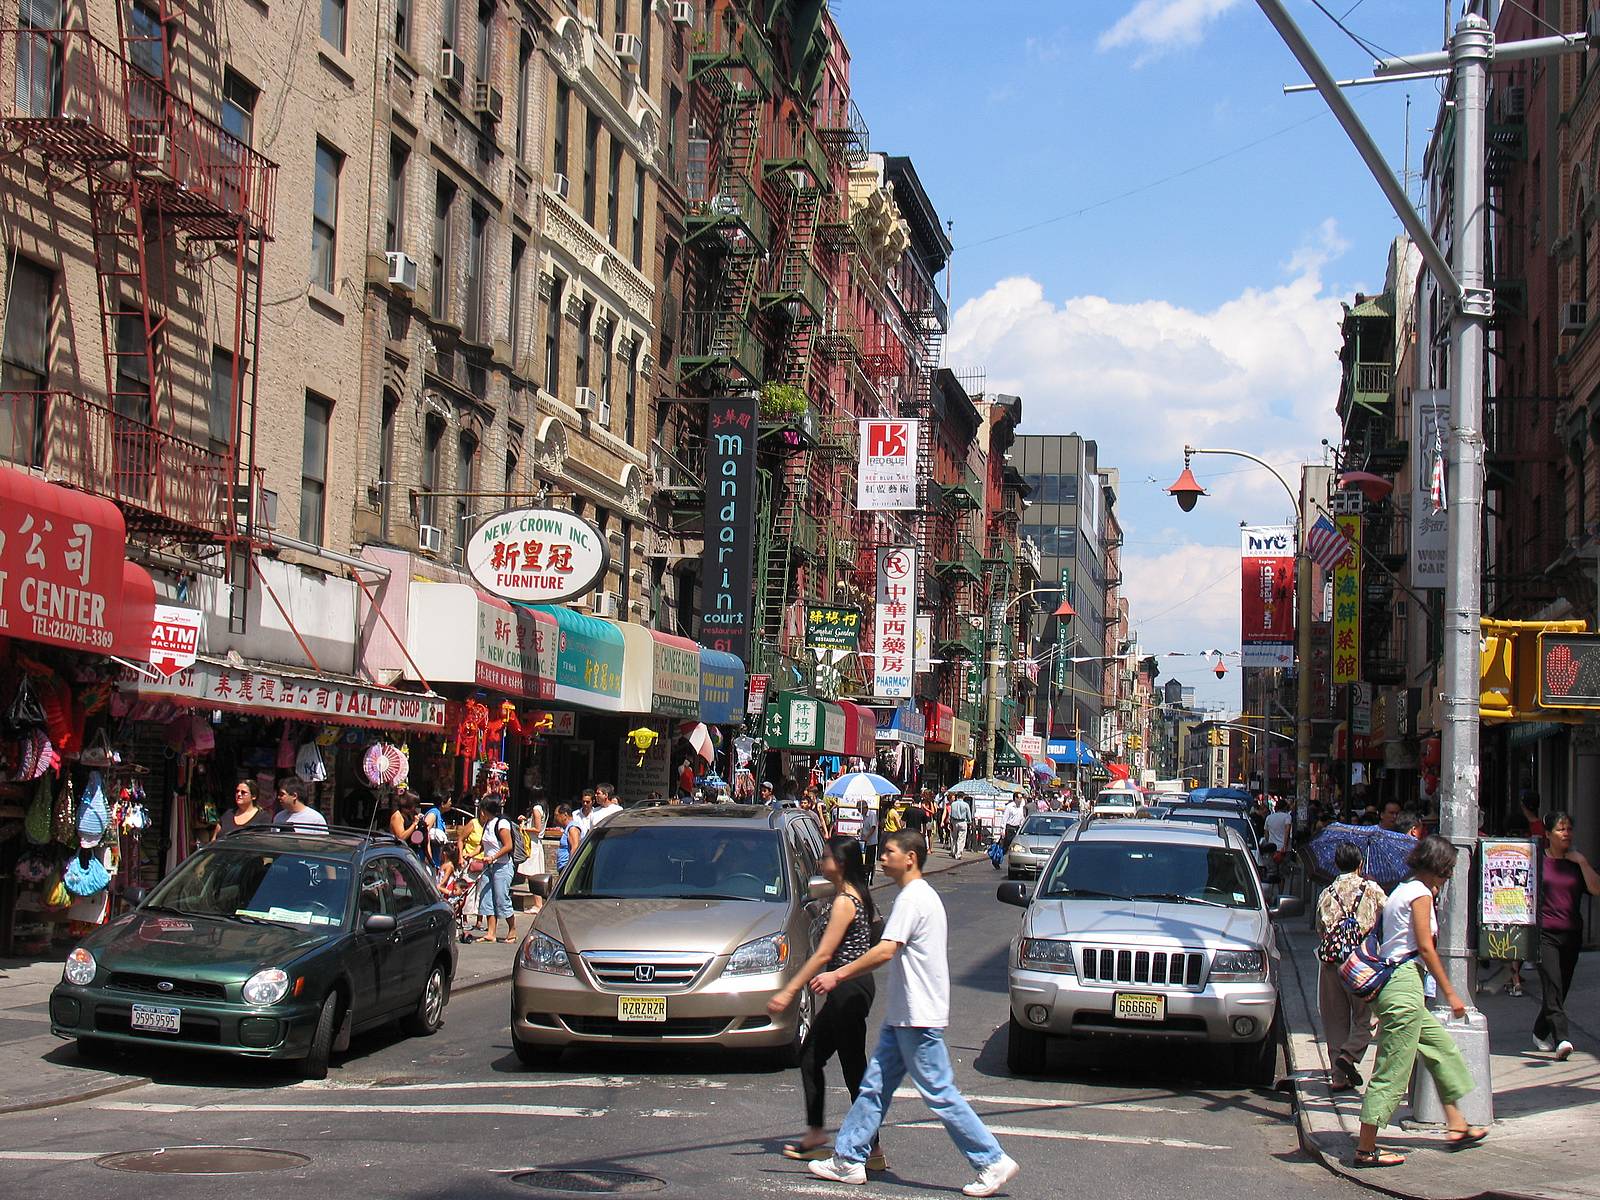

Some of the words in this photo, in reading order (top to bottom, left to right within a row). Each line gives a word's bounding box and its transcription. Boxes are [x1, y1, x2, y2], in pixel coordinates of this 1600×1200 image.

[886, 457, 905, 465] BLUE
[714, 434, 743, 610] mandarin
[484, 521, 512, 543] NEW
[520, 518, 563, 536] CROWN
[569, 526, 591, 552] INC.
[1249, 535, 1287, 550] NYC
[490, 540, 574, 574] 新皇冠
[496, 574, 565, 590] FURNITURE
[20, 577, 105, 628] CENTER
[703, 612, 744, 624] court
[152, 625, 195, 644] ATM
[494, 617, 545, 653] 新皇冠
[703, 627, 743, 635] restaurant
[834, 627, 855, 638] Garden
[881, 584, 907, 673] 中華西藥房
[151, 640, 193, 650] MACHINE
[714, 639, 733, 652] 61
[487, 645, 505, 662] NEW
[506, 651, 532, 671] CROWN
[876, 675, 910, 687] PHARMACY
[214, 671, 330, 709] 美麗禮品公司
[885, 687, 900, 695] 65
[379, 696, 398, 716] GIFT
[399, 699, 420, 718] SHOP
[622, 1002, 665, 1015] RZRZRZR
[1119, 1000, 1158, 1014] 666666
